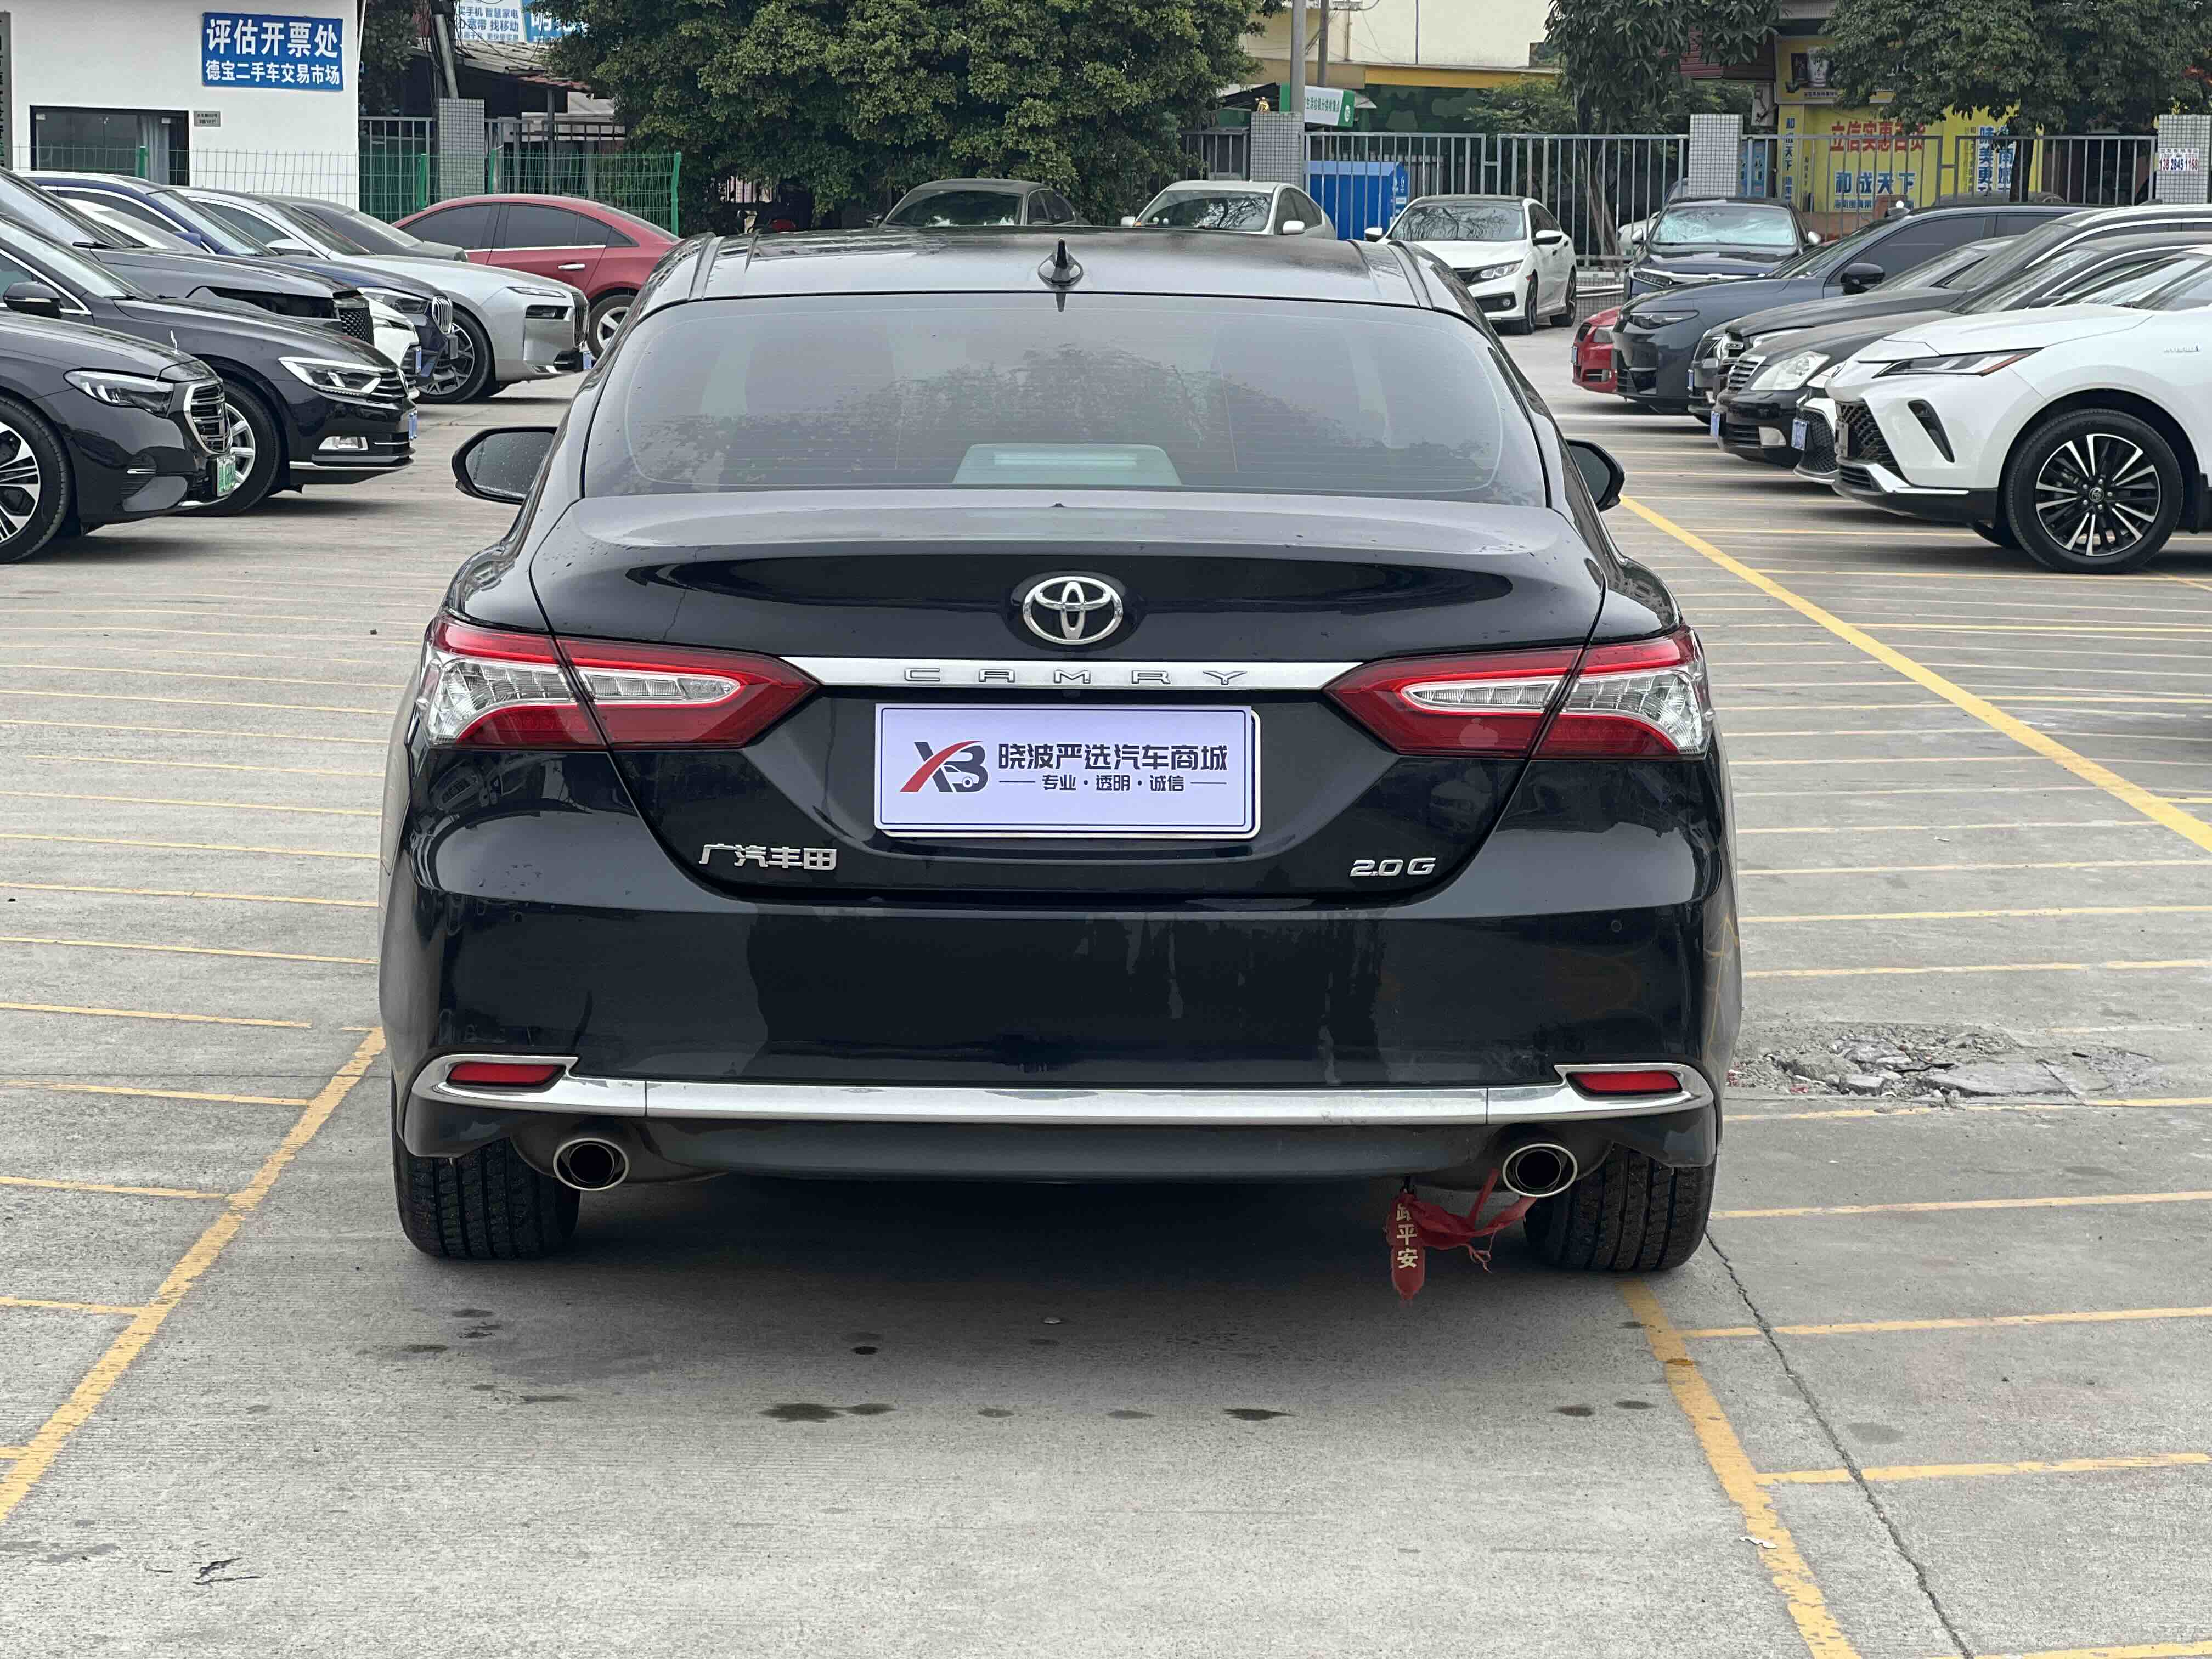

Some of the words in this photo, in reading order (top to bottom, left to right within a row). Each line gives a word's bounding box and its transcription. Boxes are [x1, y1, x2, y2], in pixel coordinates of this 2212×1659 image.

[206, 18, 338, 58] 评估开票处
[206, 60, 340, 84] 德宝二手车交易市场
[1835, 172, 1915, 194] 和成天下
[904, 667, 1248, 685] CAMRY
[998, 743, 1228, 771] 晓波严选汽车商城
[698, 843, 837, 870] 广汽丰田
